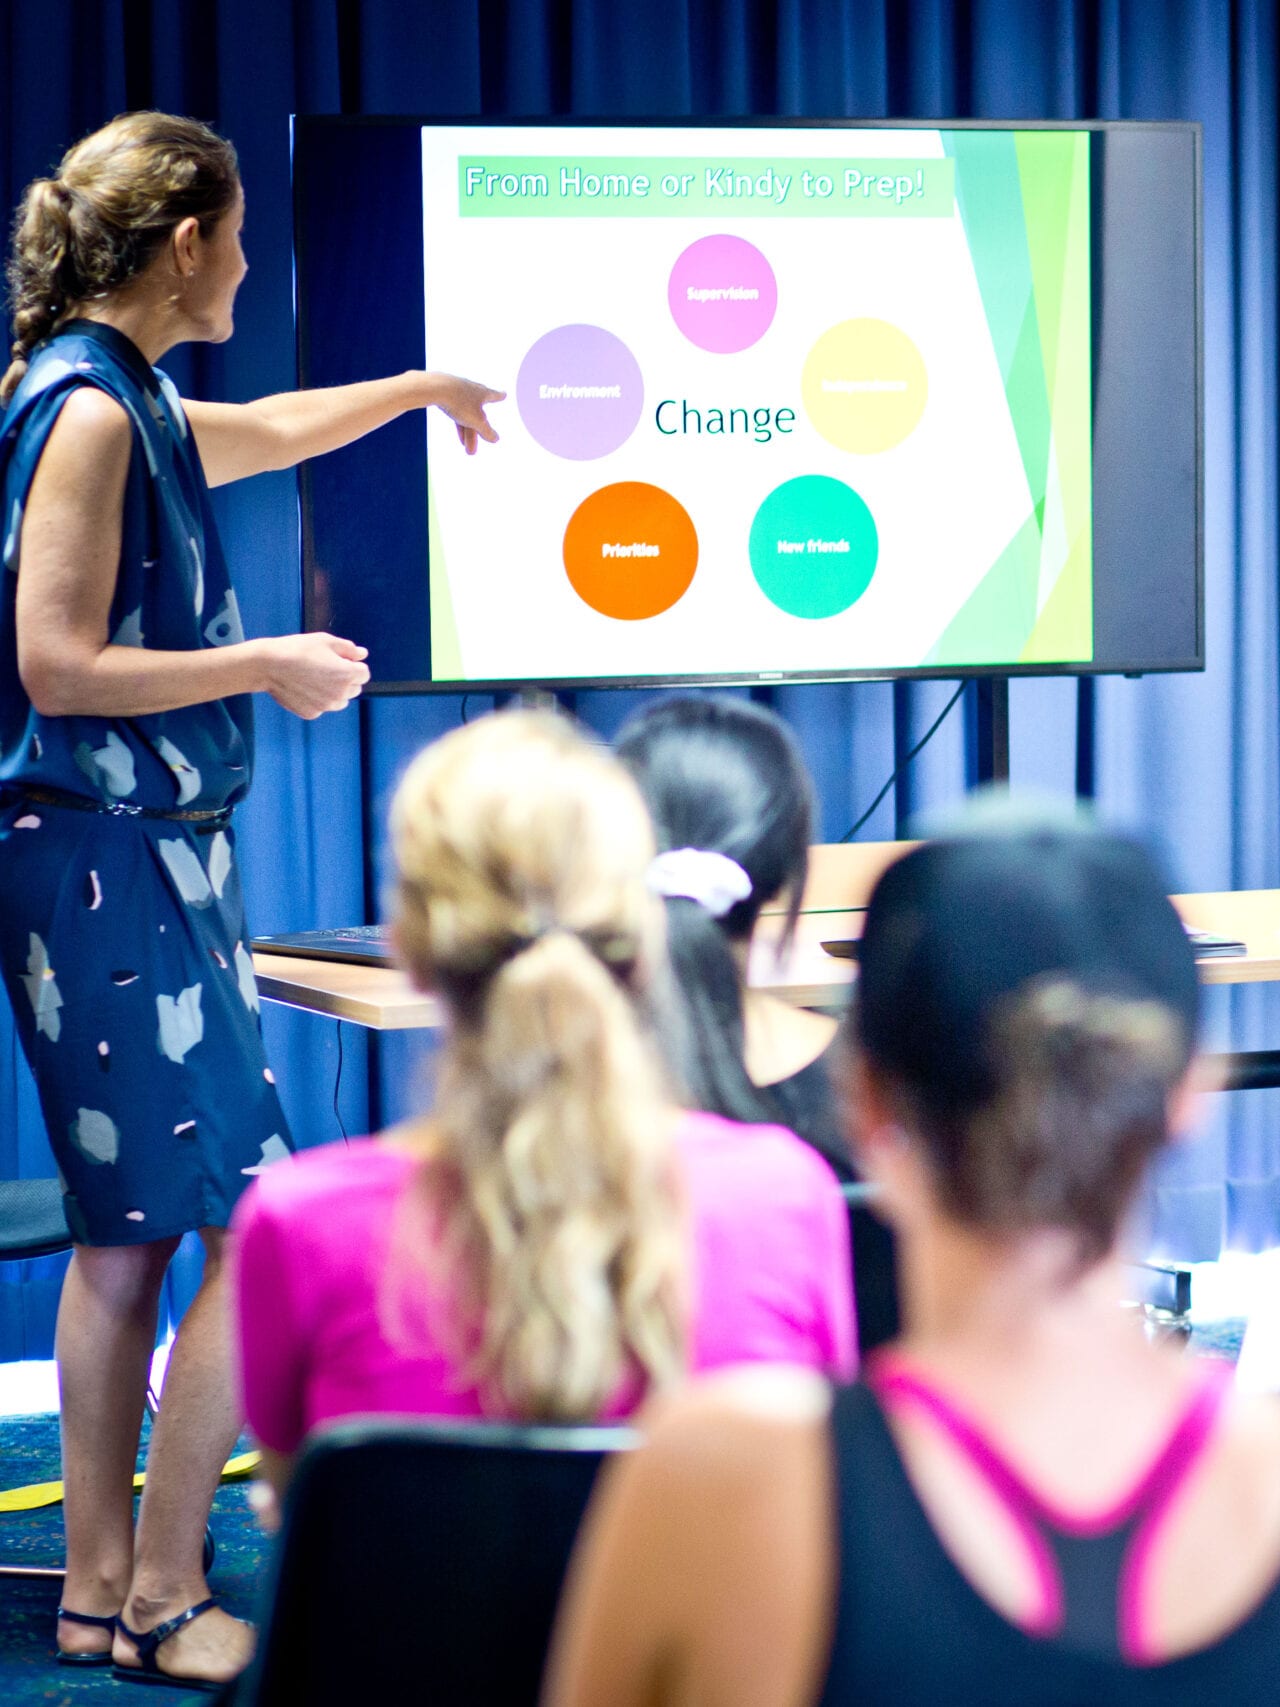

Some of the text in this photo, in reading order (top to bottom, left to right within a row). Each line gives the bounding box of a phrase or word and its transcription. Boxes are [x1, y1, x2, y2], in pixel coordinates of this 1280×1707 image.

[466, 167, 924, 204] From Home or Kindy to Prep!
[687, 286, 760, 303] Supervision
[539, 384, 621, 399] Environment
[655, 399, 796, 443] Change
[602, 543, 660, 558] Priorities
[777, 538, 850, 554] New friends
